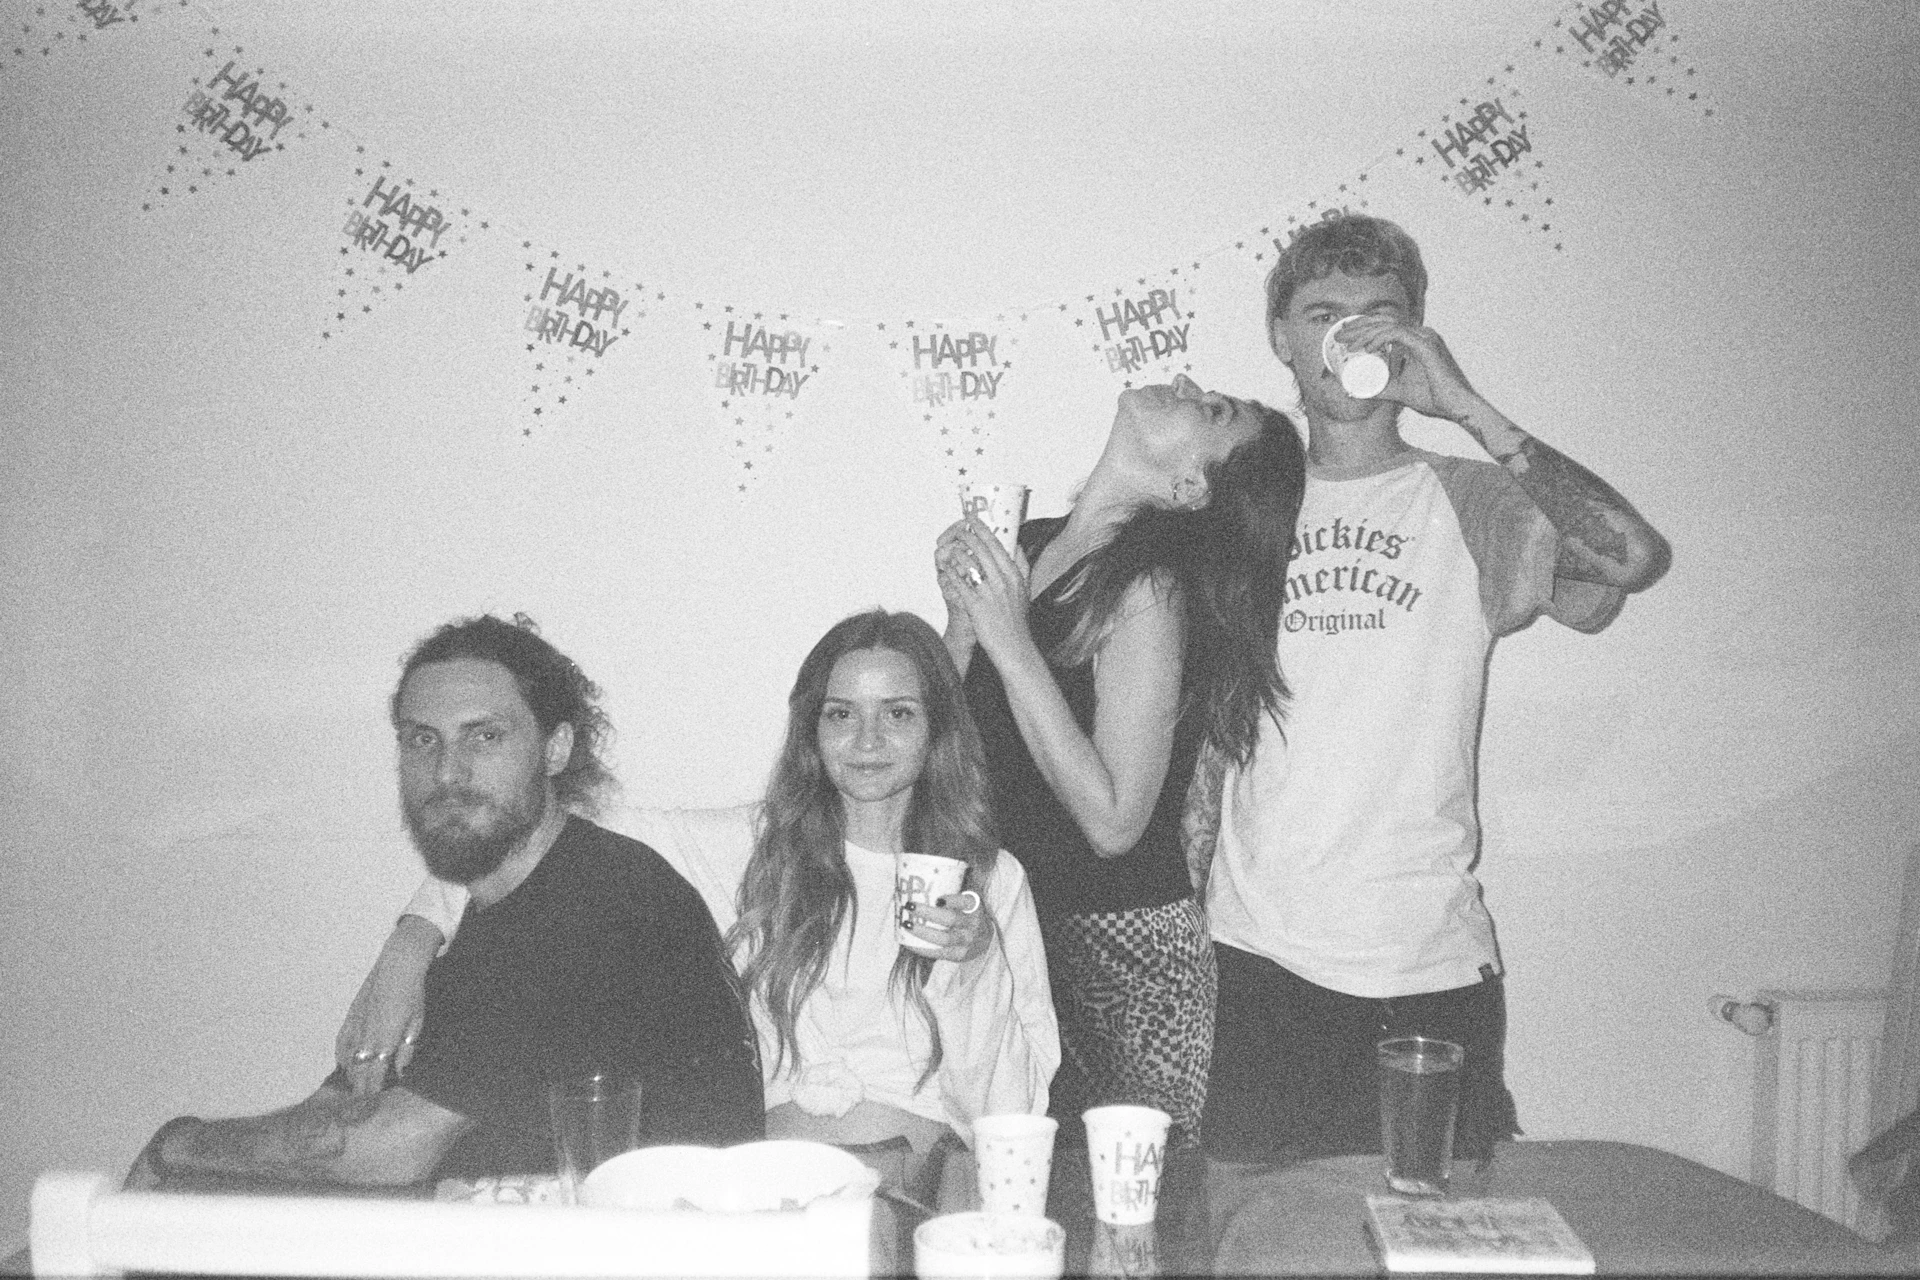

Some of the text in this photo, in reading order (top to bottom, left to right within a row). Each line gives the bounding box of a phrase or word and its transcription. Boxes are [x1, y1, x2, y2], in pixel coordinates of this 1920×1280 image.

[184, 92, 272, 162] BIRTHDAY
[207, 60, 294, 140] HAPPY
[1430, 97, 1516, 168] HAPPY
[1453, 124, 1533, 196] BIRTHDAY
[363, 175, 451, 249] HAPPY
[342, 209, 435, 274] BIRTHDAY
[540, 266, 629, 329] HAPPY
[1095, 288, 1182, 341] HAPPY
[523, 304, 619, 358] BIRTHDAY
[723, 320, 812, 368] HAPPY
[912, 332, 998, 369] HAPPY
[1104, 323, 1190, 374] BIRTHDAY
[714, 362, 811, 400] BIRTHDAY
[912, 370, 1005, 408] BIRTHDAY
[1284, 608, 1386, 636] Original
